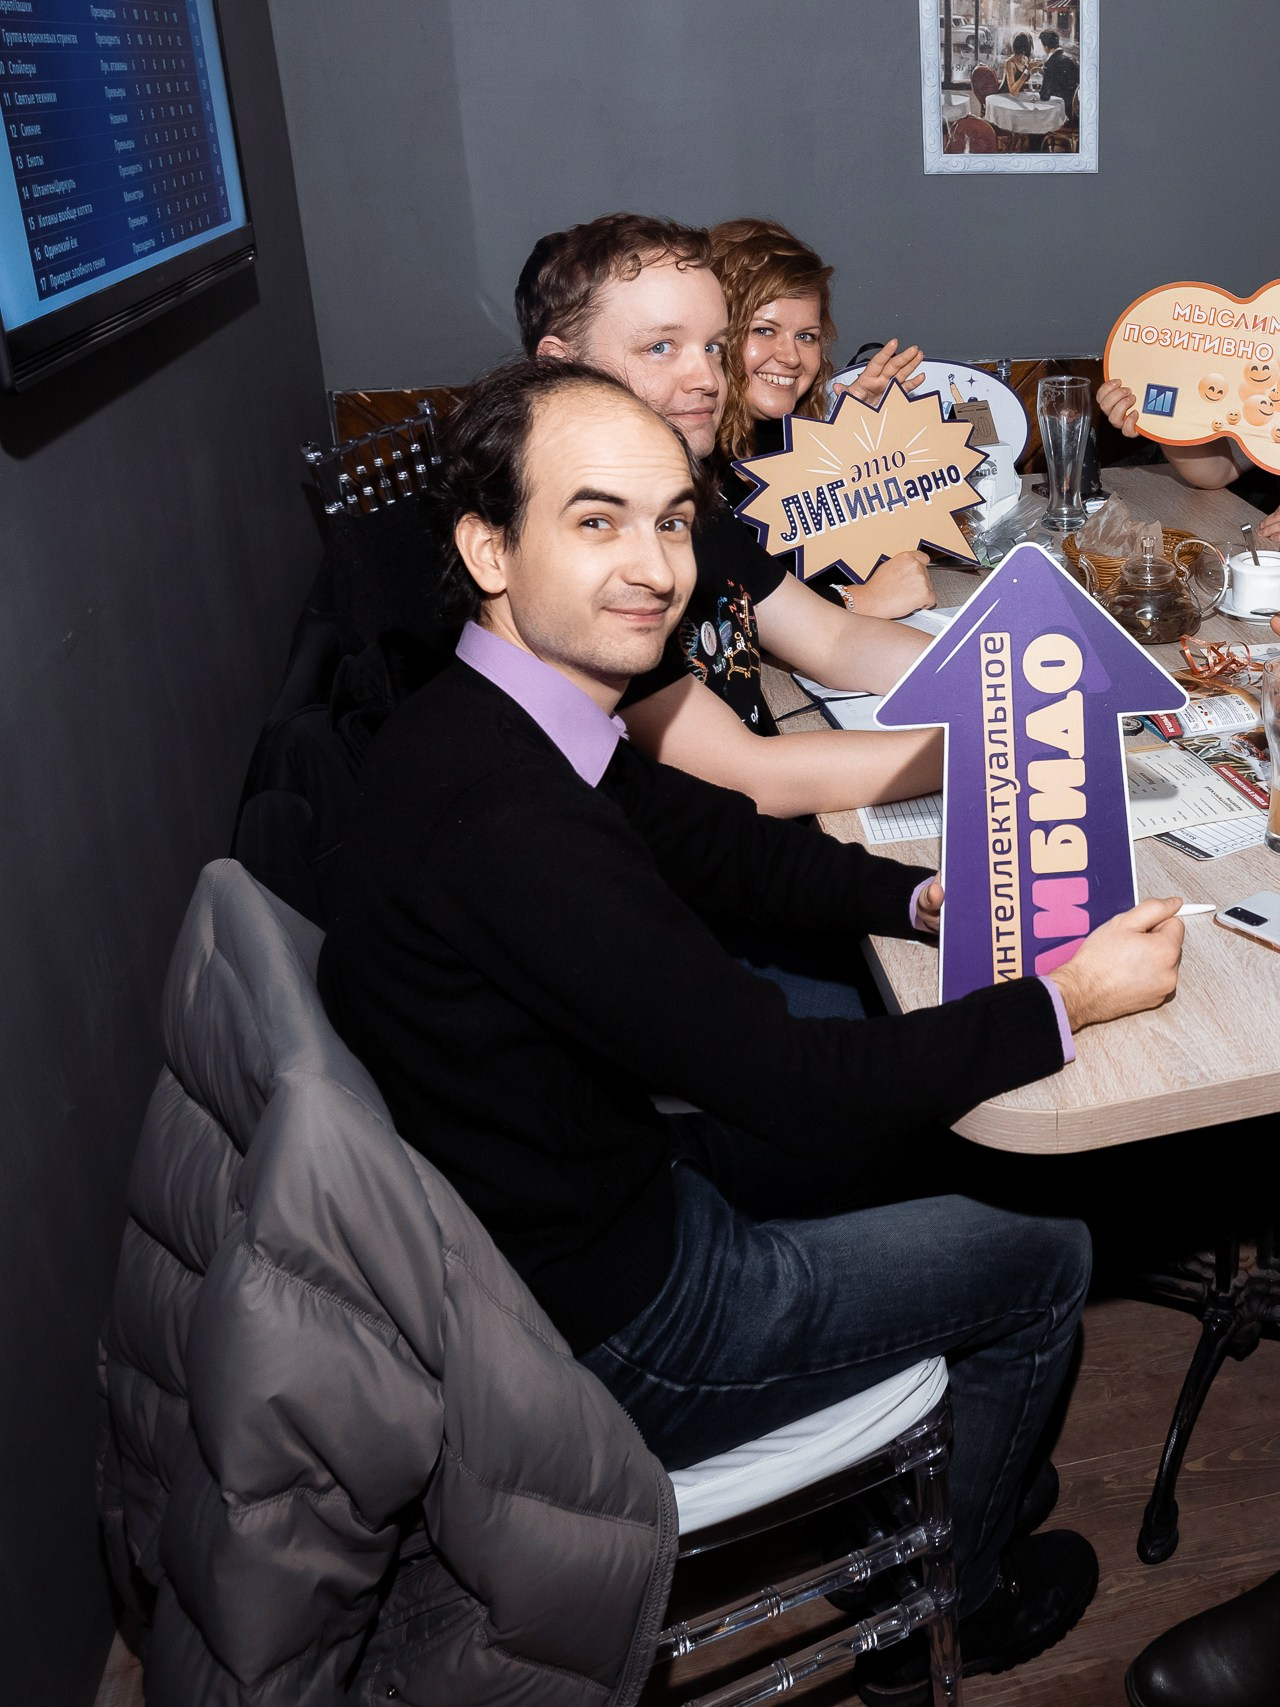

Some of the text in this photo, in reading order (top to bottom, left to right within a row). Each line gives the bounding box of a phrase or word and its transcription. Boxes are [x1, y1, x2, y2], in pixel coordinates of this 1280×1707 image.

[2, 28, 22, 47] Группа
[27, 33, 57, 47] оранжевых
[95, 32, 120, 47] Президенты
[9, 59, 37, 77] Спойлеры
[3, 92, 11, 107] 11
[14, 91, 35, 106] Святые
[35, 92, 57, 104] техники
[10, 124, 18, 138] 12
[20, 123, 41, 137] Сияние
[16, 156, 23, 169] 13
[26, 154, 44, 168] Еноты
[22, 186, 29, 200] 14
[32, 178, 76, 198] ШтангенЦиркуль
[118, 163, 143, 179] Президенты
[28, 216, 35, 230] 15
[38, 213, 58, 228] Котаны
[58, 206, 77, 222] вообще
[77, 203, 93, 216] котята
[34, 247, 42, 261] 16
[44, 236, 71, 260] Одинокий
[70, 236, 79, 249] ёж
[40, 277, 47, 291] 17
[49, 270, 72, 290] Призрак
[72, 263, 93, 279] злобного
[92, 257, 106, 271] гения
[132, 238, 155, 256] Президенты
[1123, 323, 1274, 361] ПОЗИТИВНО
[850, 450, 906, 483] это
[969, 466, 998, 479] ime
